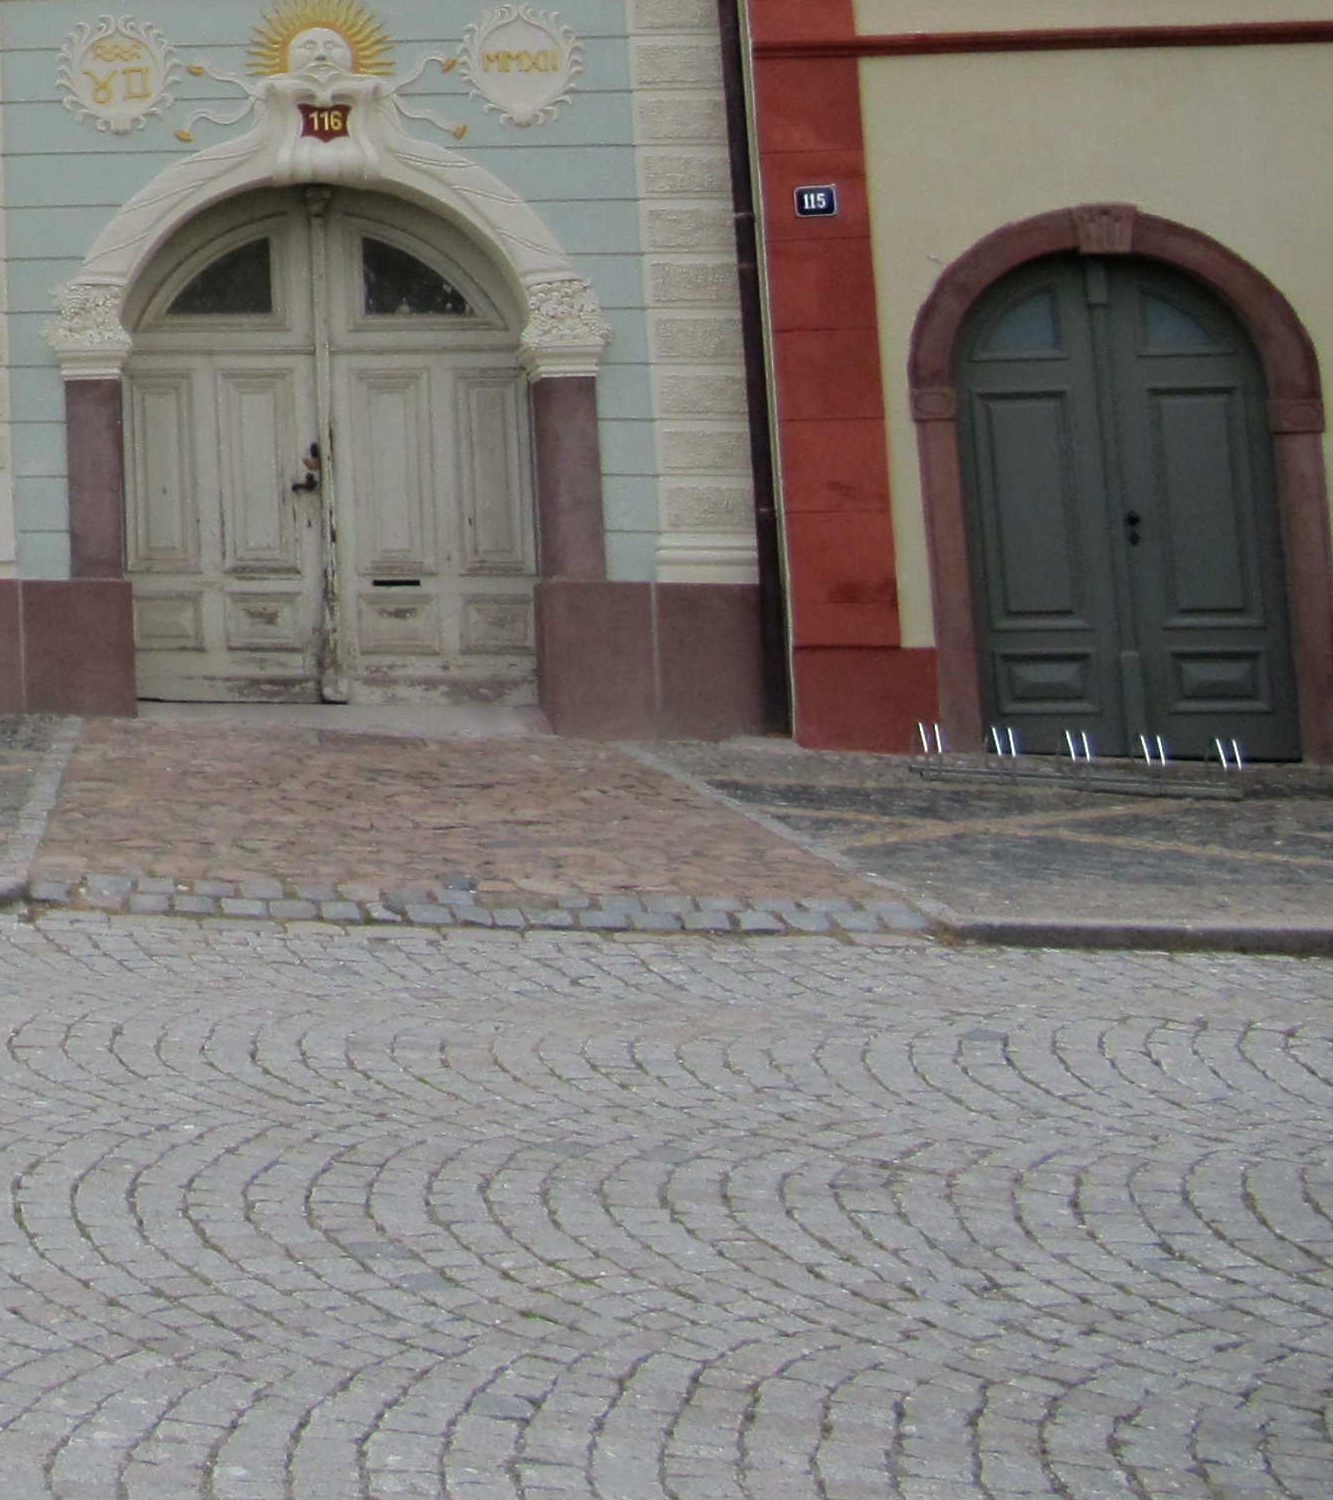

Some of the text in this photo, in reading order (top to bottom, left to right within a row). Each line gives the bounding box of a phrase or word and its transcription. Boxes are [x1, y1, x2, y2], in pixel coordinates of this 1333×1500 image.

[483, 49, 560, 72] MMXII
[309, 110, 343, 131] 116
[803, 193, 826, 209] 115
